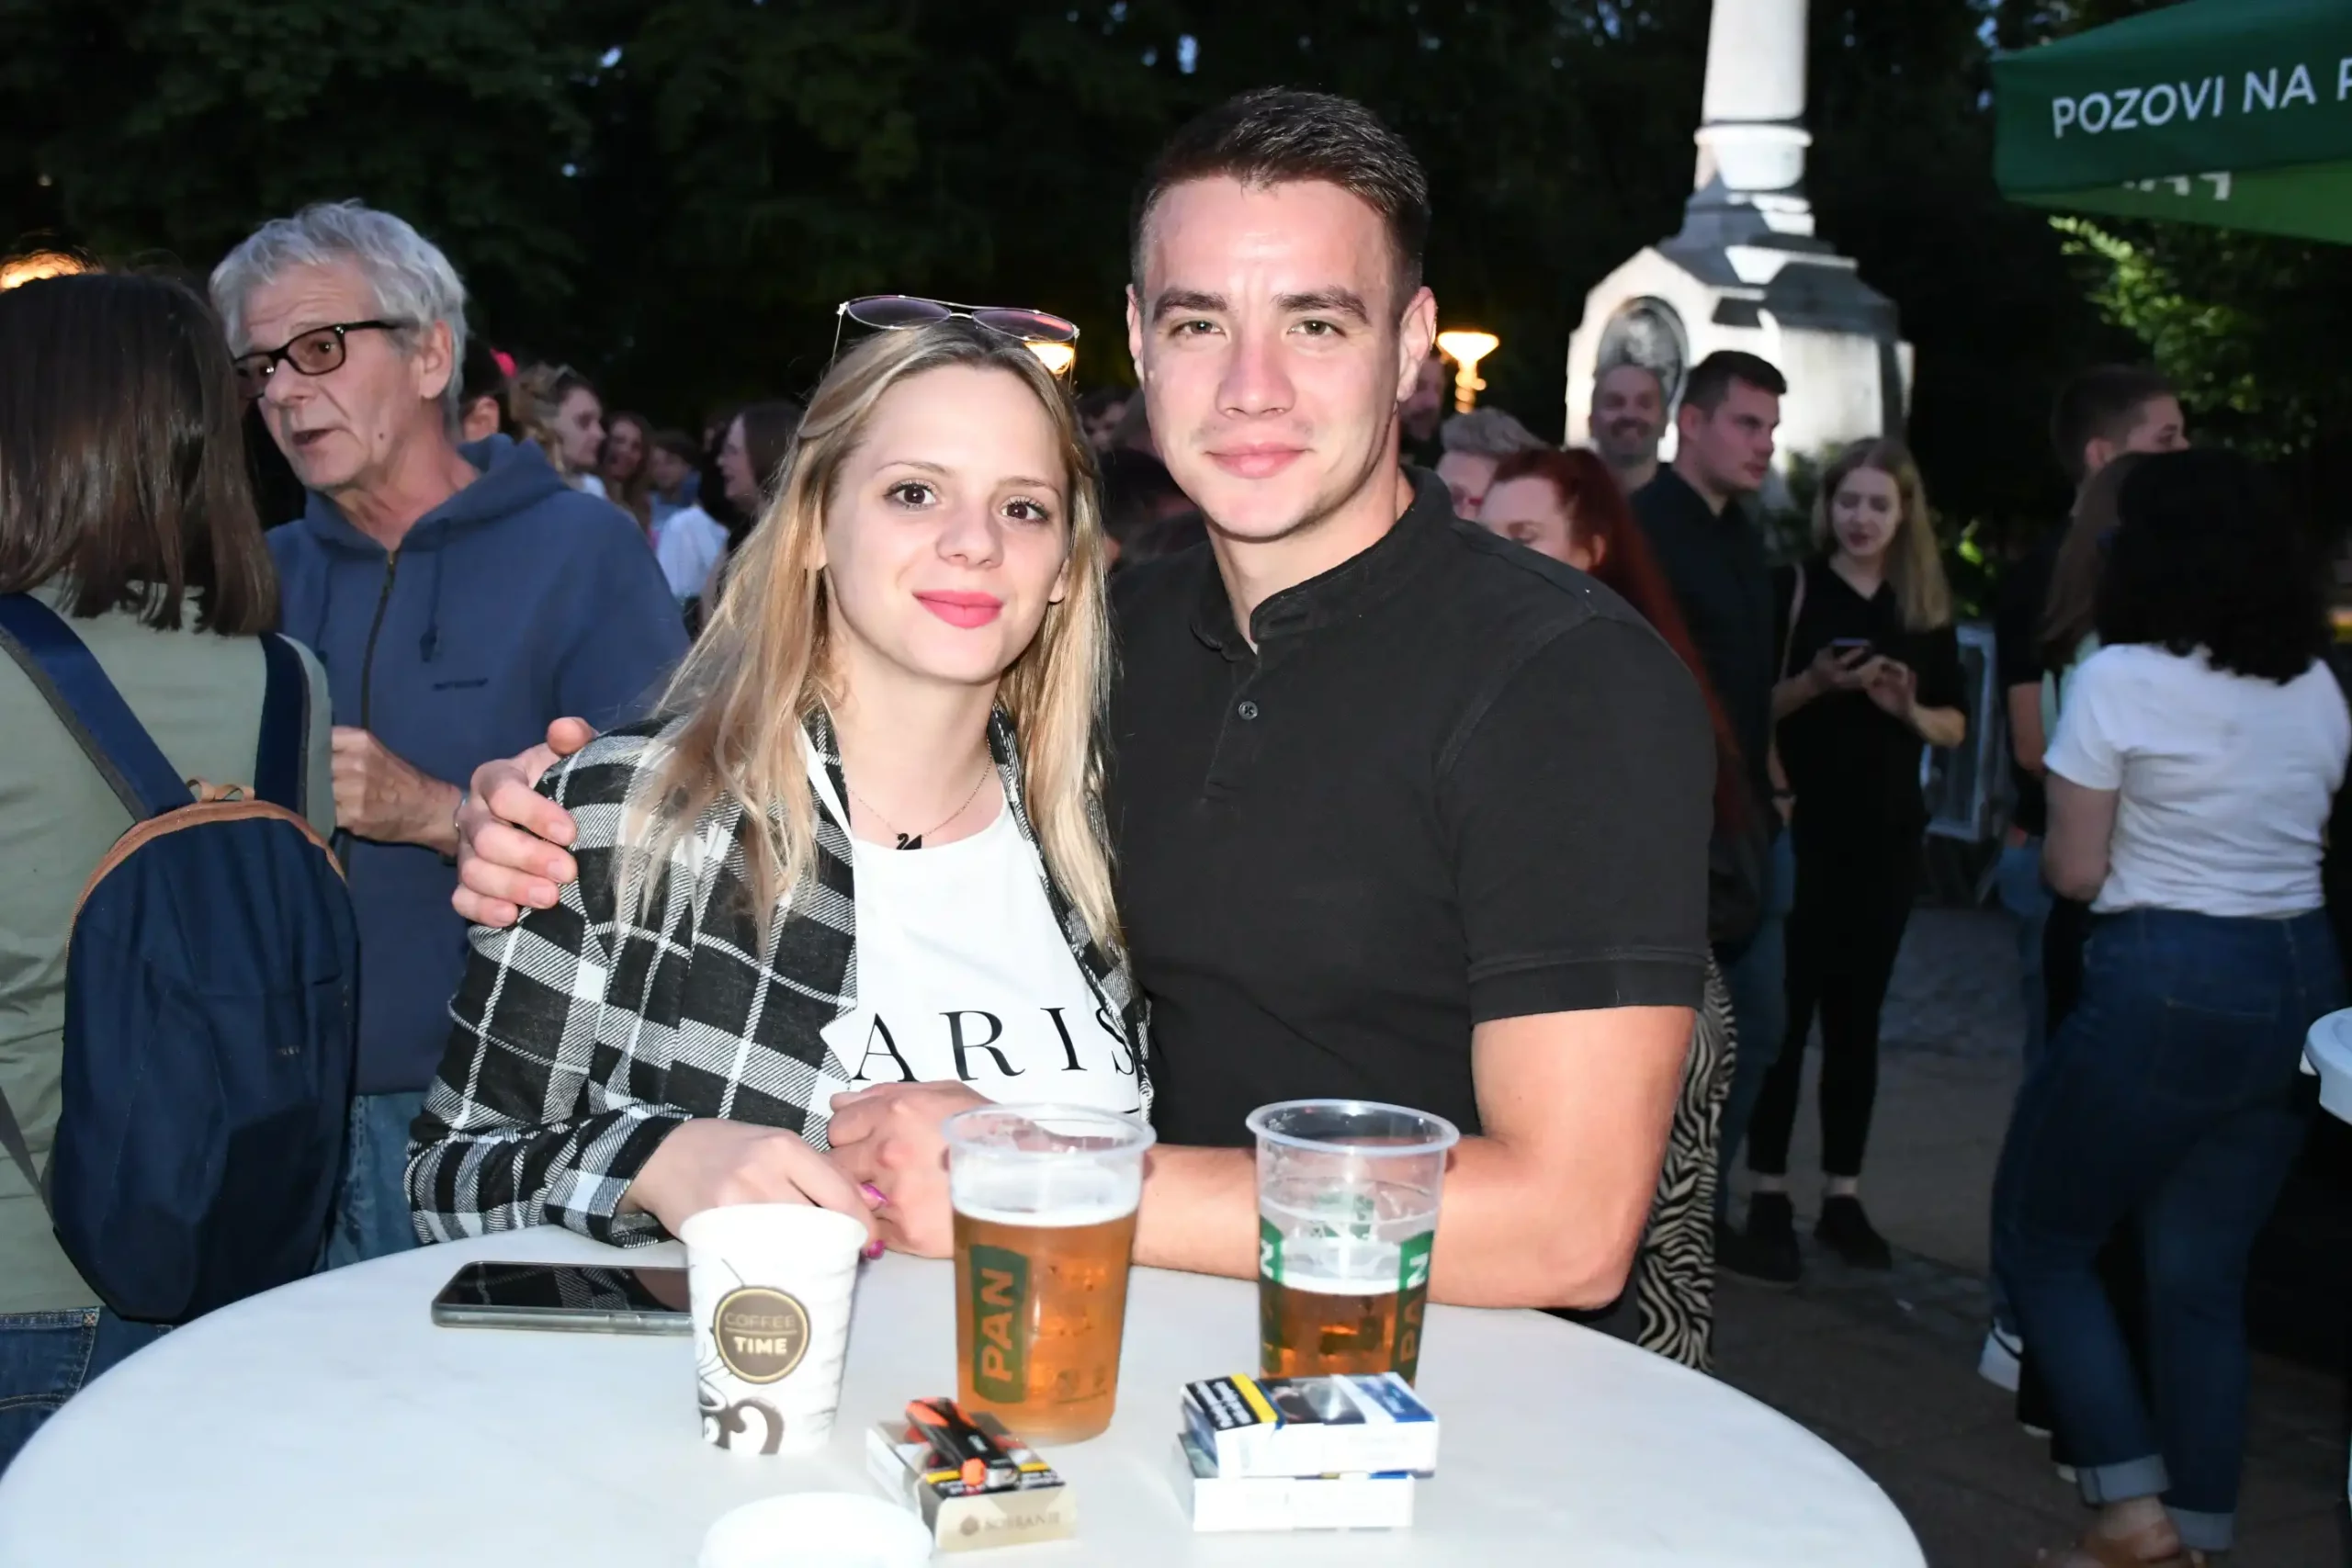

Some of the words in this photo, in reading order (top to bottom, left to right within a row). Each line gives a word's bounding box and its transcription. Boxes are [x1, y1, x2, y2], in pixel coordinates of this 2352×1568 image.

[2052, 75, 2224, 139] POZOVI
[2242, 63, 2317, 113] NA
[724, 1312, 796, 1329] COFFEE
[980, 1268, 1014, 1382] PAN
[733, 1336, 787, 1355] TIME
